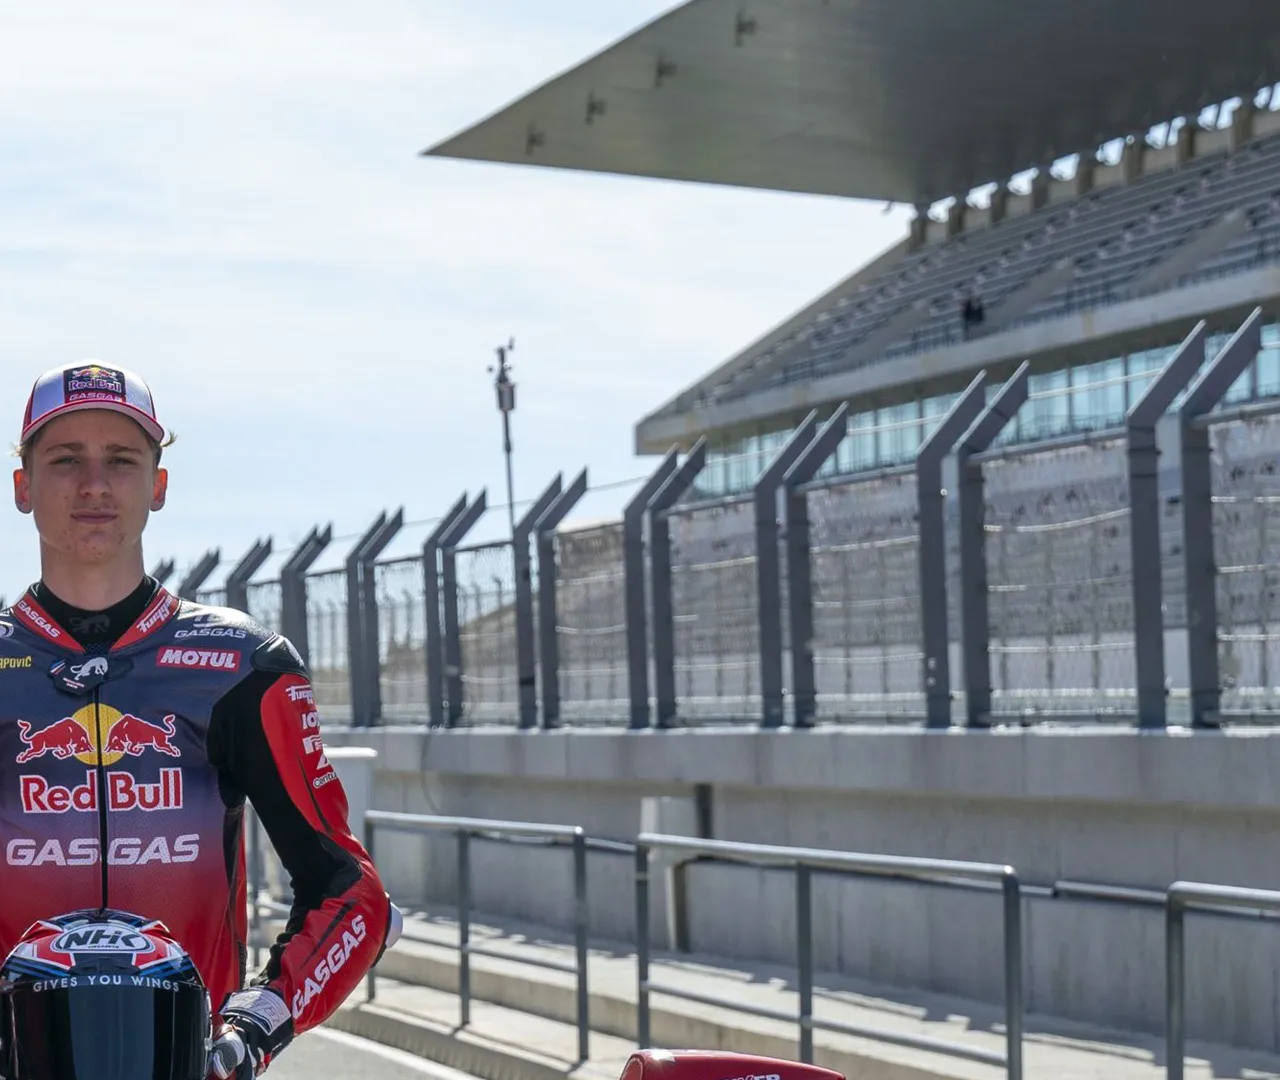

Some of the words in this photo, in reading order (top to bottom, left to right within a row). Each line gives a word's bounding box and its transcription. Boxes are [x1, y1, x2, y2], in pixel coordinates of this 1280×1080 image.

[68, 377, 96, 391] Red
[97, 378, 122, 391] Bull
[17, 600, 61, 638] GASGAS
[174, 620, 246, 639] GASGAS
[159, 649, 236, 668] MOTUL
[19, 769, 97, 813] Red
[107, 767, 184, 811] Bull
[6, 833, 200, 866] GASGAS
[291, 914, 367, 1020] GASGAS
[33, 977, 78, 992] GIVES
[87, 975, 125, 986] YOU
[131, 976, 180, 992] WINGS
